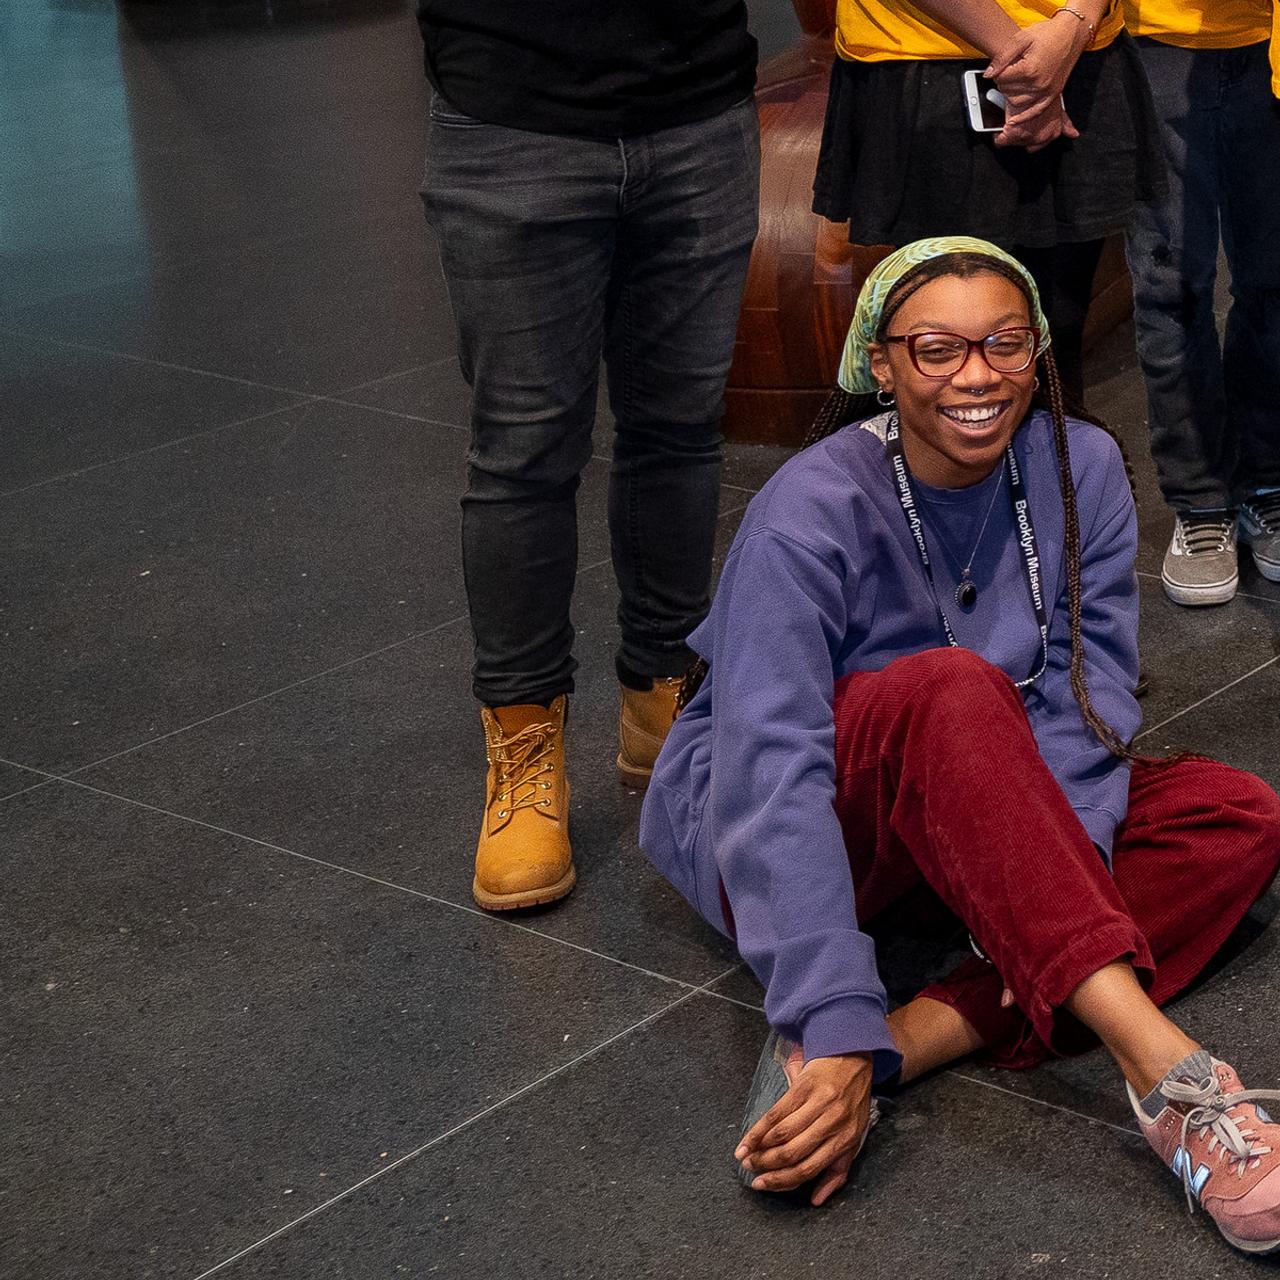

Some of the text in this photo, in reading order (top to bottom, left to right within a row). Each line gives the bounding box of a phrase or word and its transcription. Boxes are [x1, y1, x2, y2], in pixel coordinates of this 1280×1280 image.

[893, 455, 915, 509] Museum
[1007, 441, 1020, 485] useum
[908, 509, 929, 565] Brooklyn
[1016, 499, 1042, 611] Brooklyn Museum
